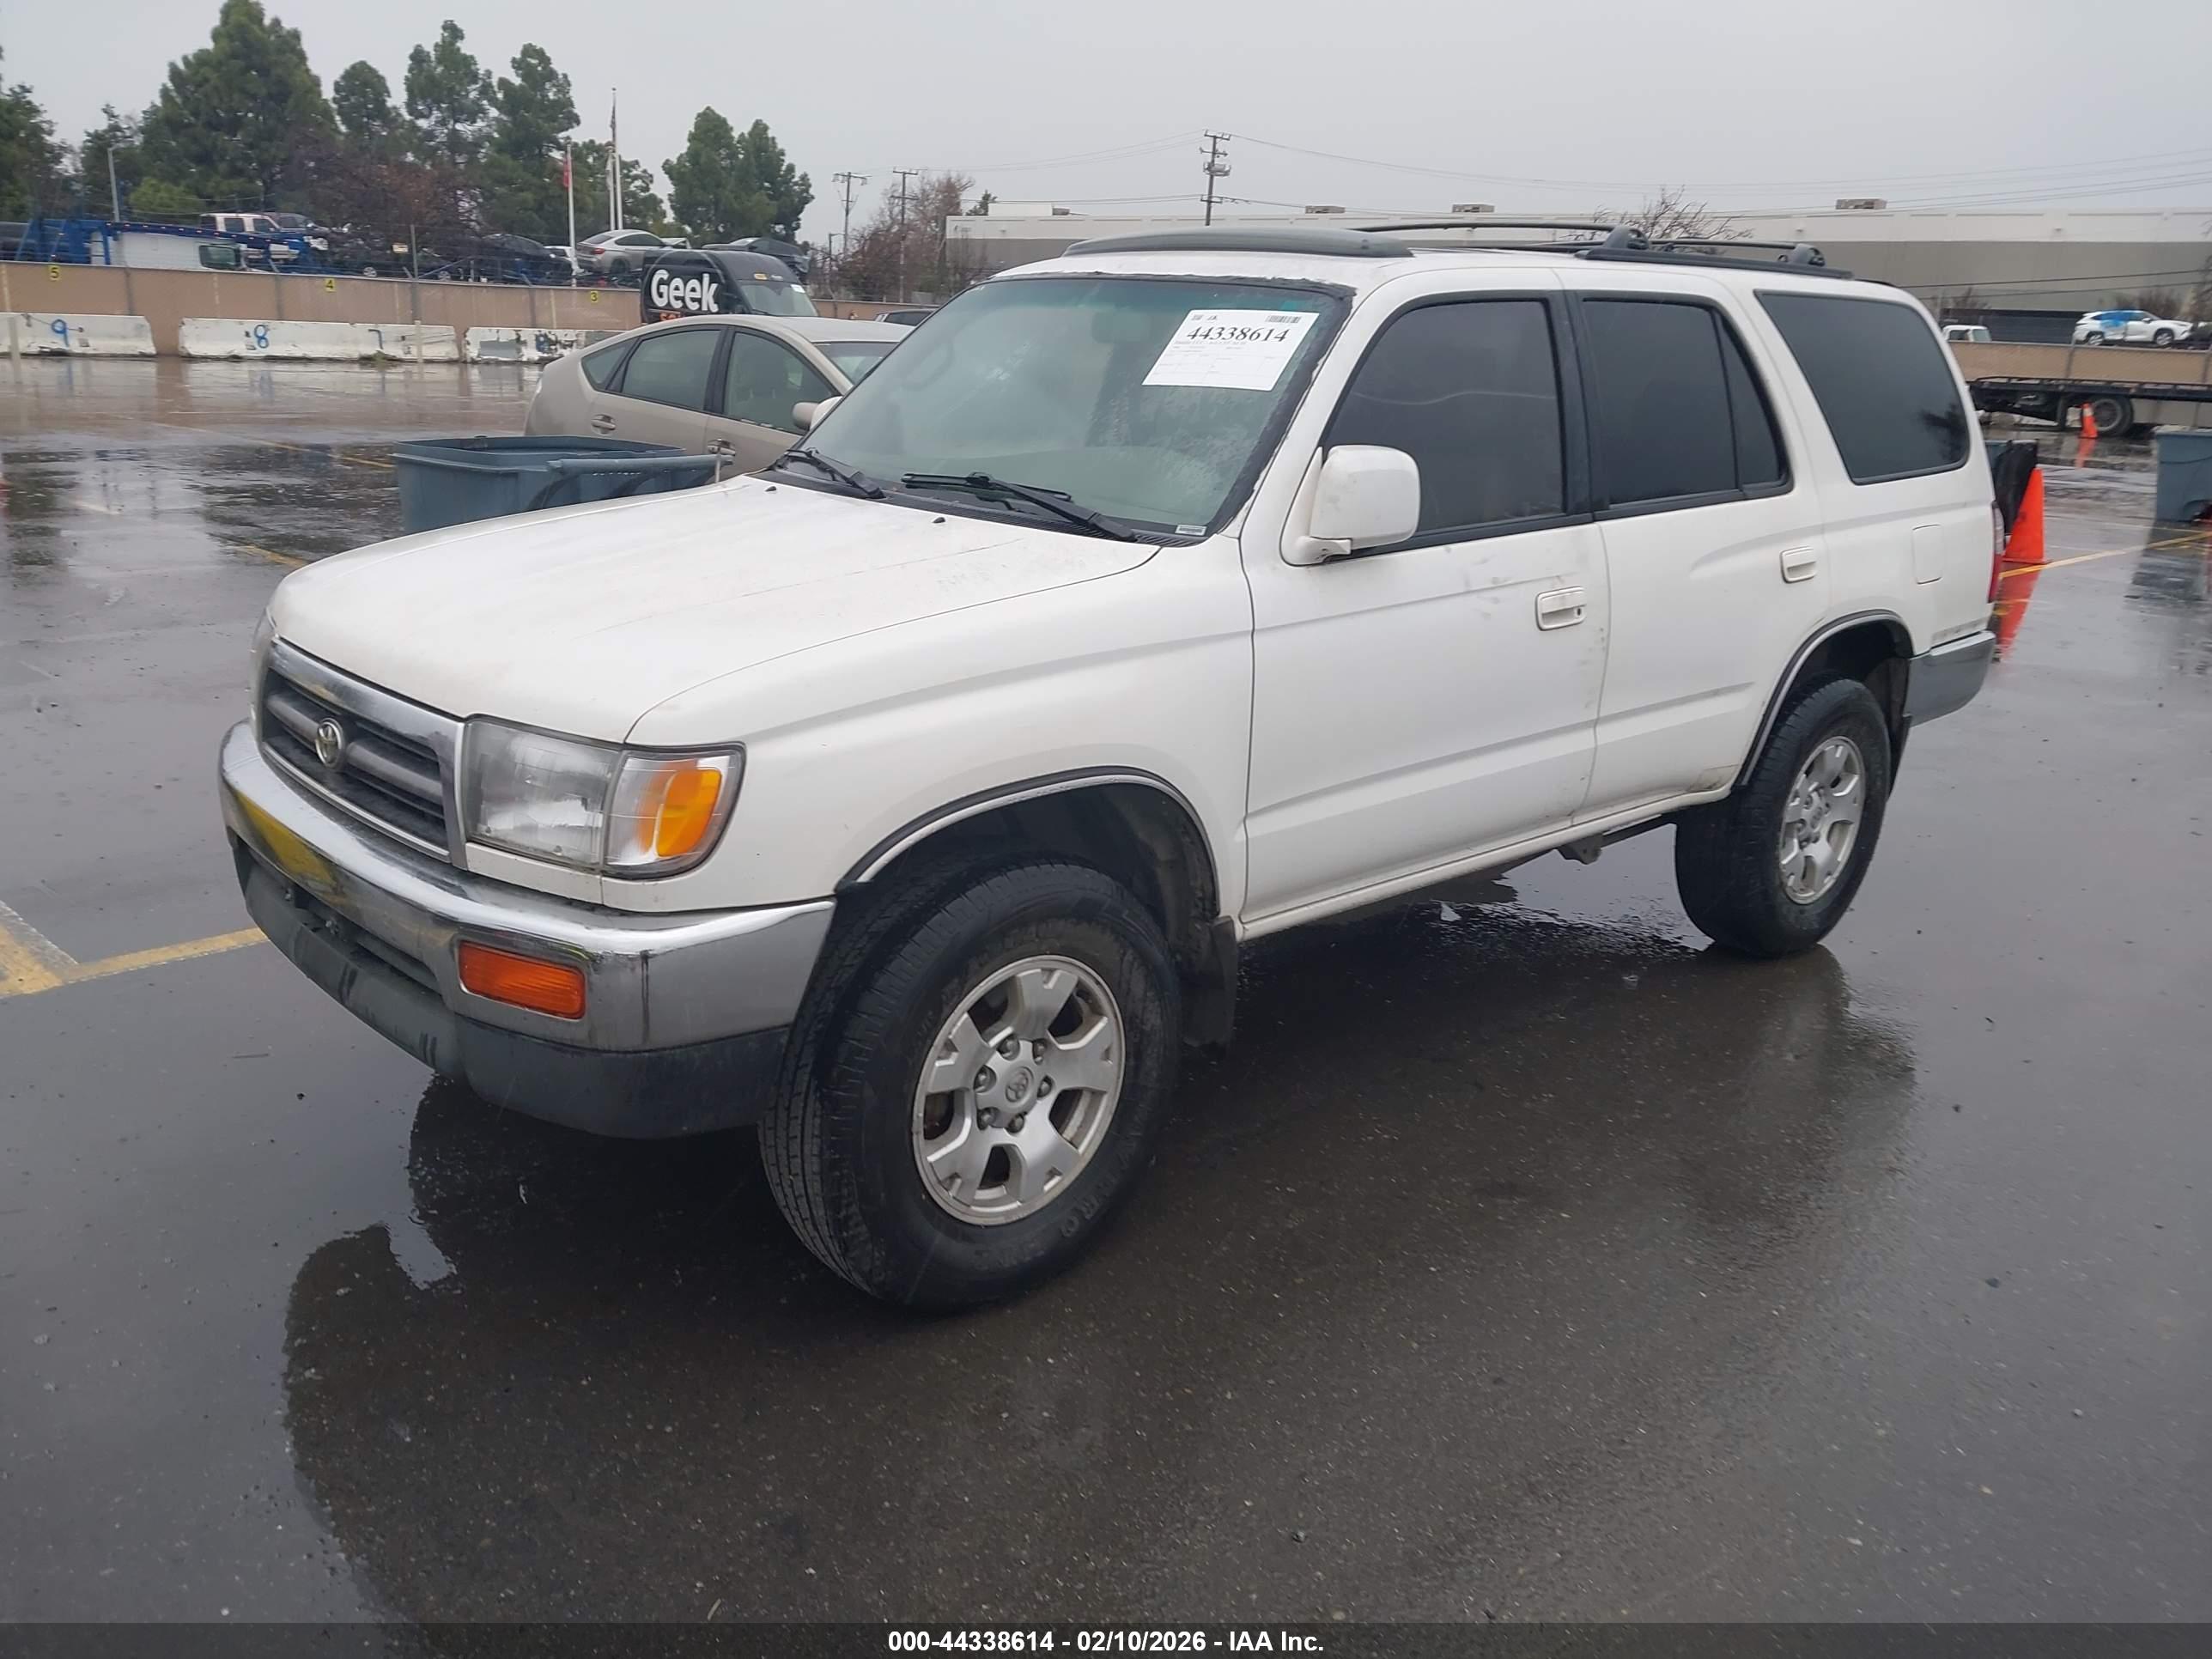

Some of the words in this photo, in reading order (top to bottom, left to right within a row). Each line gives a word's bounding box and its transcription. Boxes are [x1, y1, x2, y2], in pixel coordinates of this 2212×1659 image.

[49, 266, 60, 280] 5
[325, 278, 335, 289] 4
[650, 269, 720, 313] Geek
[589, 291, 599, 302] 3
[51, 319, 70, 347] 9
[253, 324, 270, 349] 8
[368, 328, 384, 350] 7
[1186, 325, 1291, 343] 44338614
